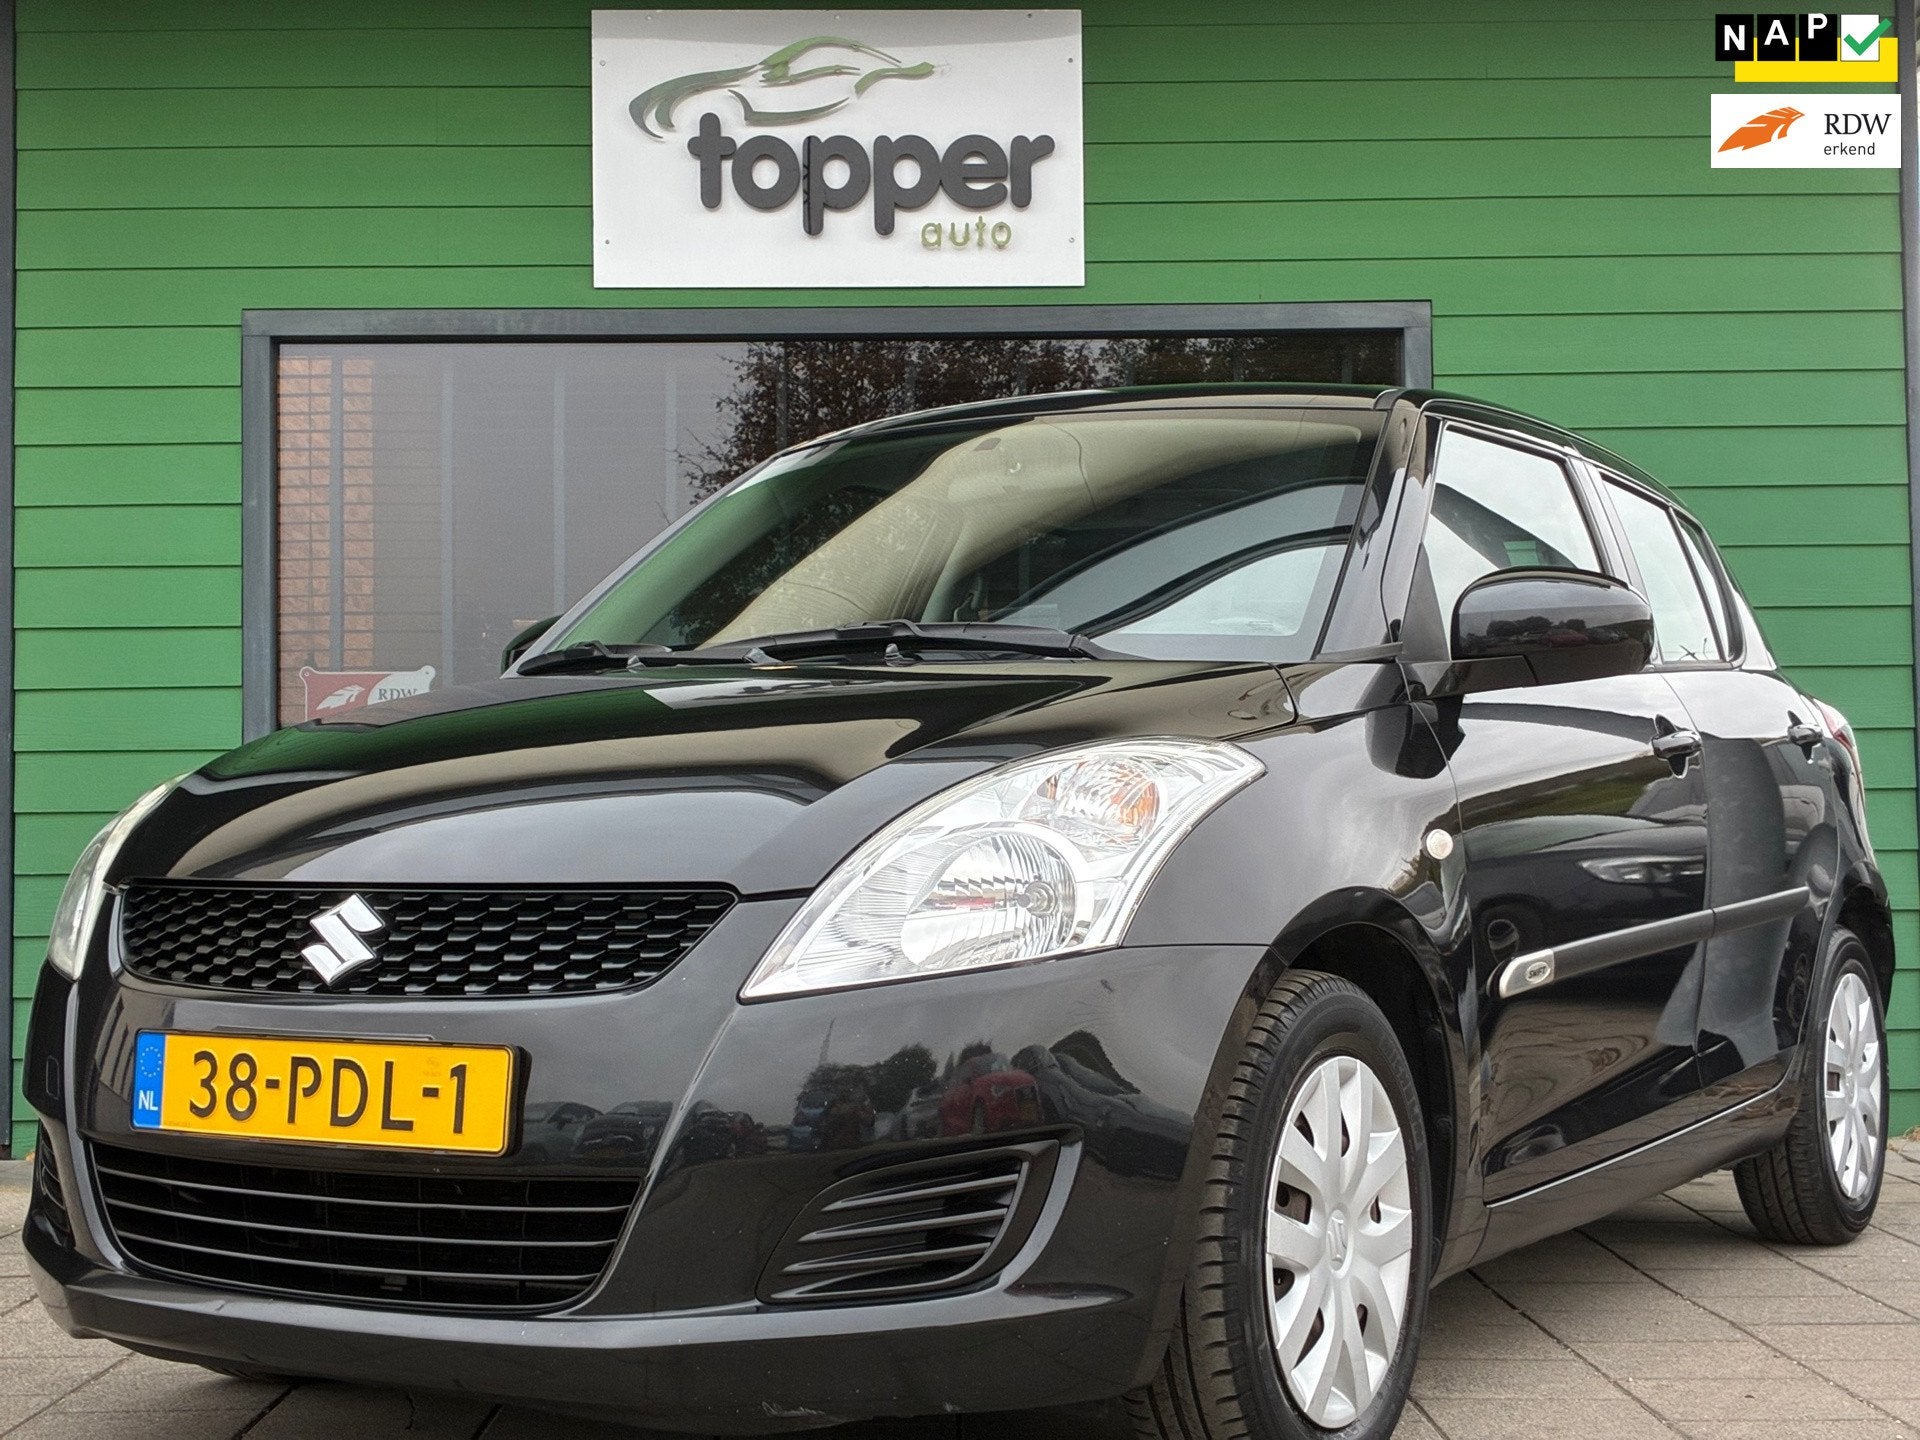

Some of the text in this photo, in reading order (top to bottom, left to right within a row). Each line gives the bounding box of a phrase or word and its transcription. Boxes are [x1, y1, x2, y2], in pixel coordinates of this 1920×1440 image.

[687, 112, 1056, 237] topper
[921, 216, 1012, 248] auto
[138, 1089, 159, 1112] NL
[189, 1050, 468, 1135] 38-PDL-1
